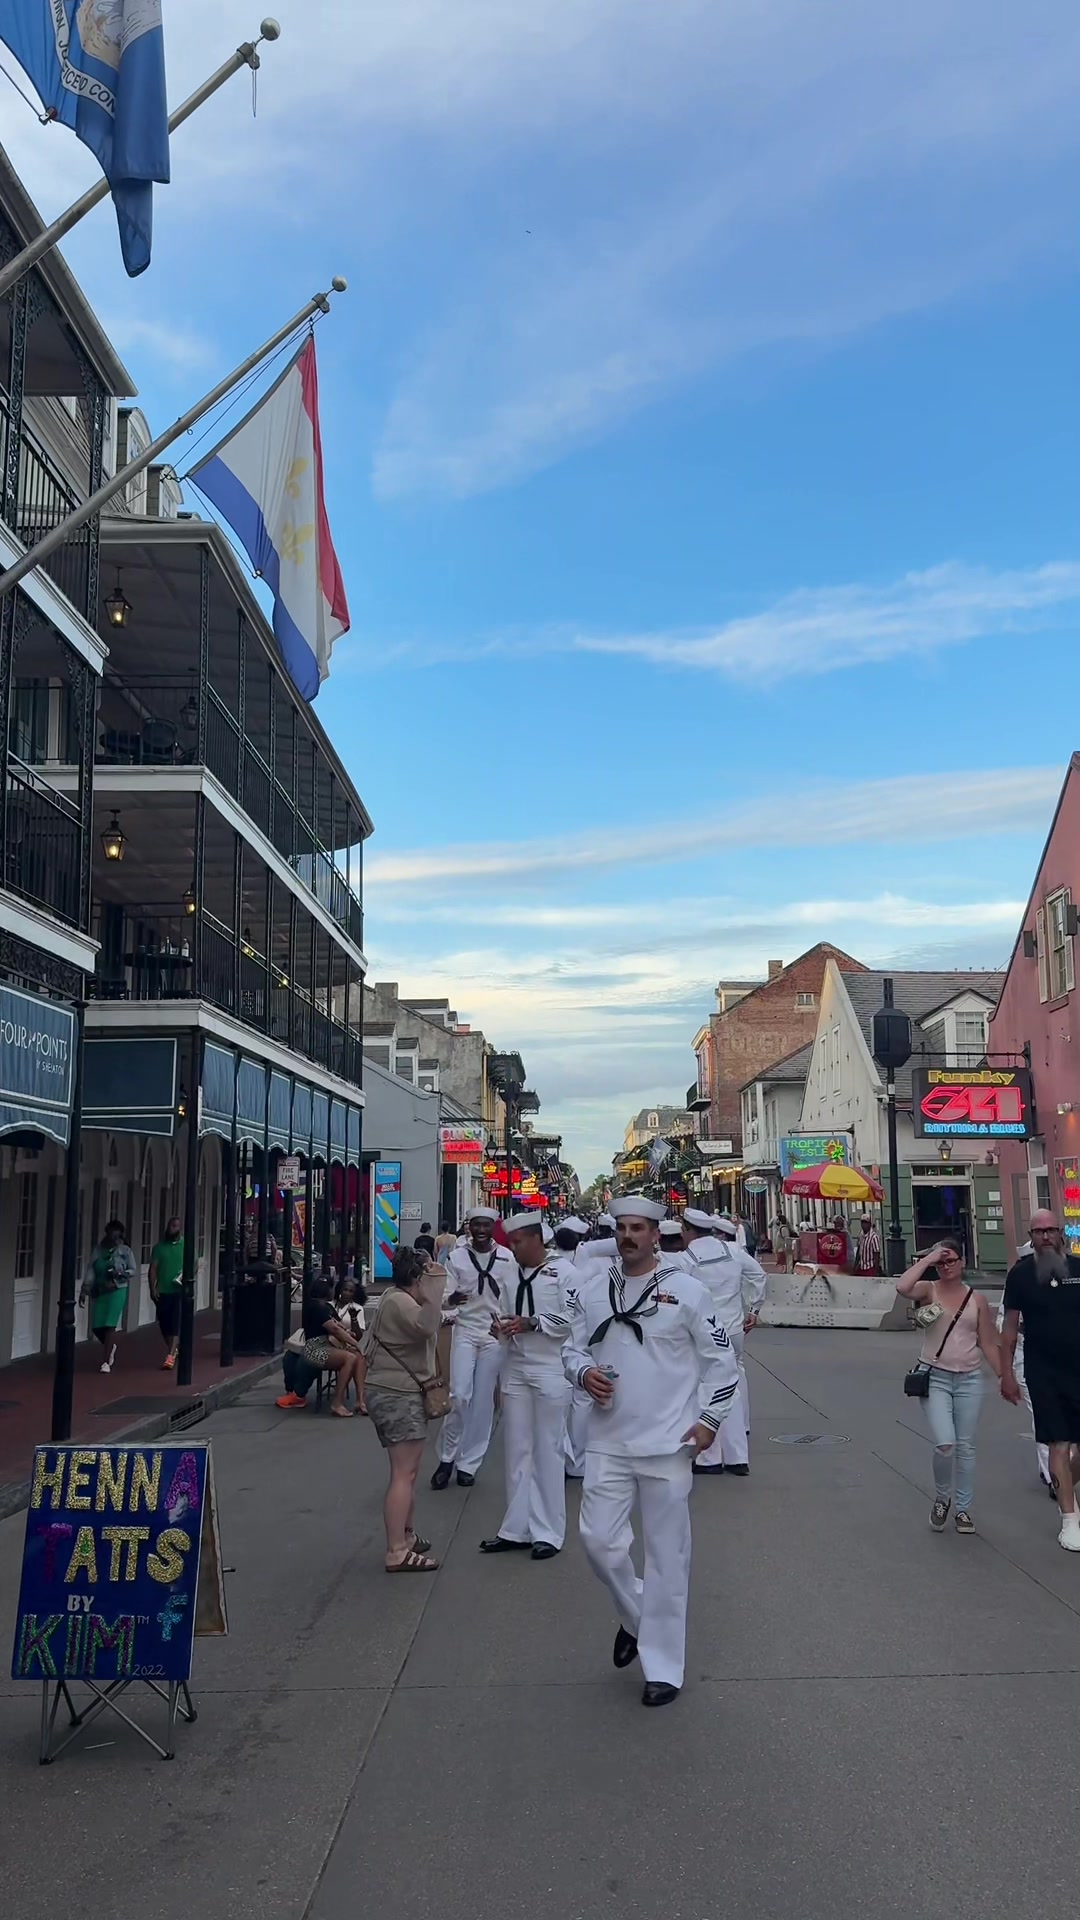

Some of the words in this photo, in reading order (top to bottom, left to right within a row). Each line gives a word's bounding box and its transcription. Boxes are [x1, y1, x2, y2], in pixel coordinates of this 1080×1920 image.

[1, 1019, 28, 1049] FOUR
[37, 1032, 67, 1061] POINTS
[928, 1070, 1015, 1085] Funky
[924, 1123, 977, 1133] RHYTHM
[978, 1123, 988, 1133] &
[990, 1123, 1026, 1133] BLUES
[785, 1139, 841, 1149] TROPICAL
[799, 1149, 828, 1157] ISLE
[31, 1451, 199, 1512] HENNA
[37, 1523, 191, 1584] TATTS
[67, 1594, 95, 1612] BY
[18, 1614, 135, 1676] KIM
[131, 1664, 166, 1676] 2022
